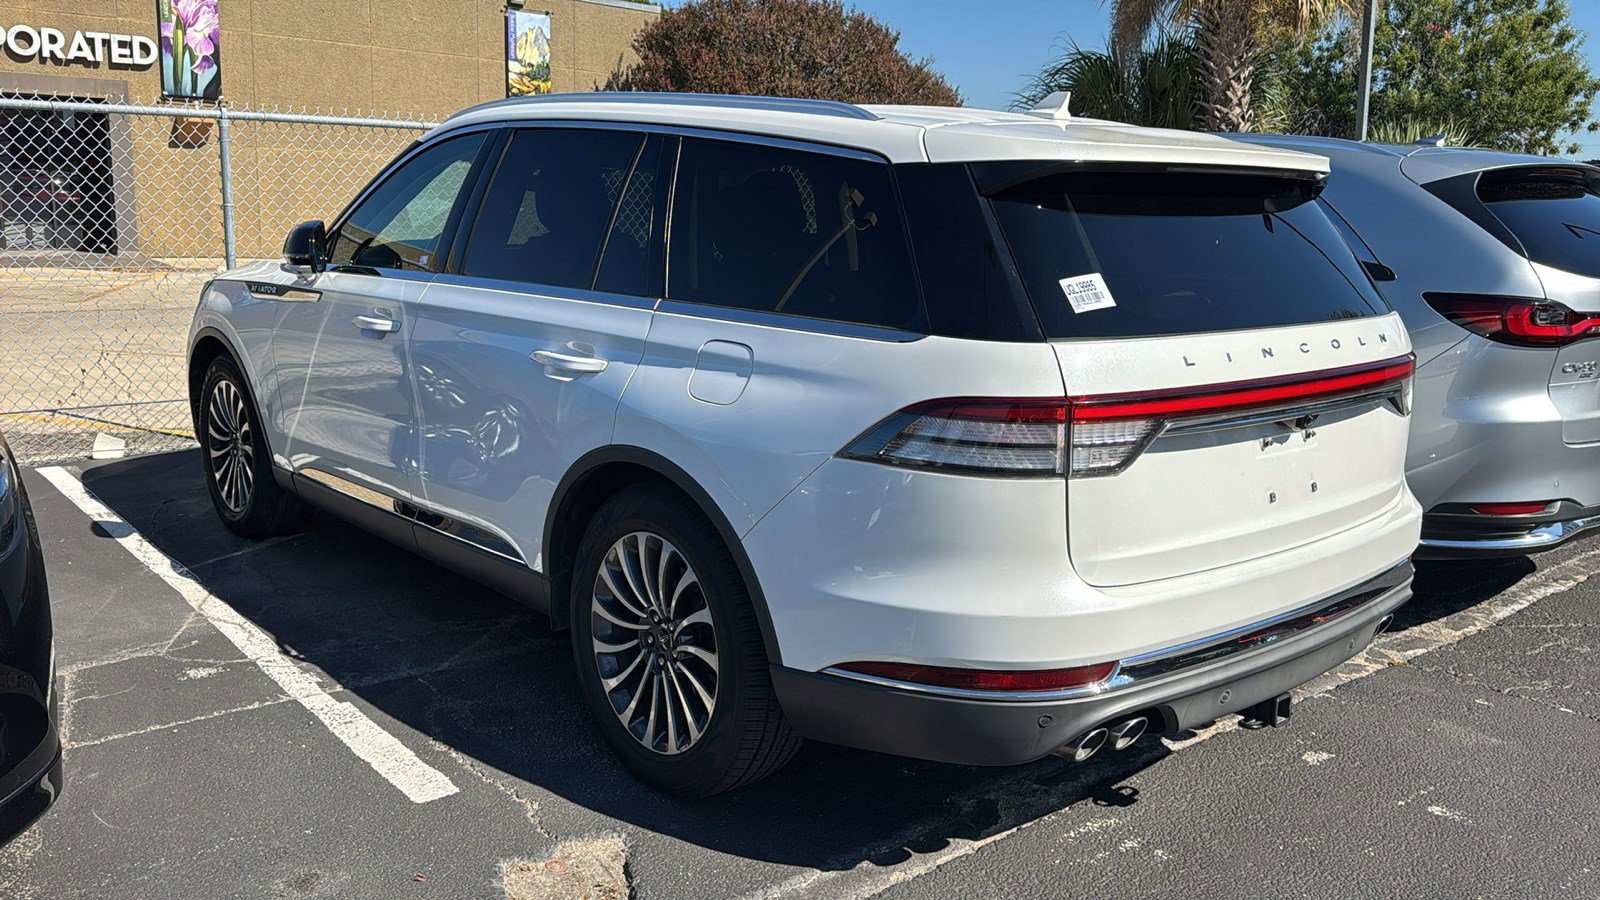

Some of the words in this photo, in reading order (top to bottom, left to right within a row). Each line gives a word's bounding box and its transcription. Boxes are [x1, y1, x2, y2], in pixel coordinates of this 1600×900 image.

[0, 25, 159, 65] ORATED
[250, 284, 277, 294] AVIATOR
[1183, 333, 1387, 367] LINCOLN
